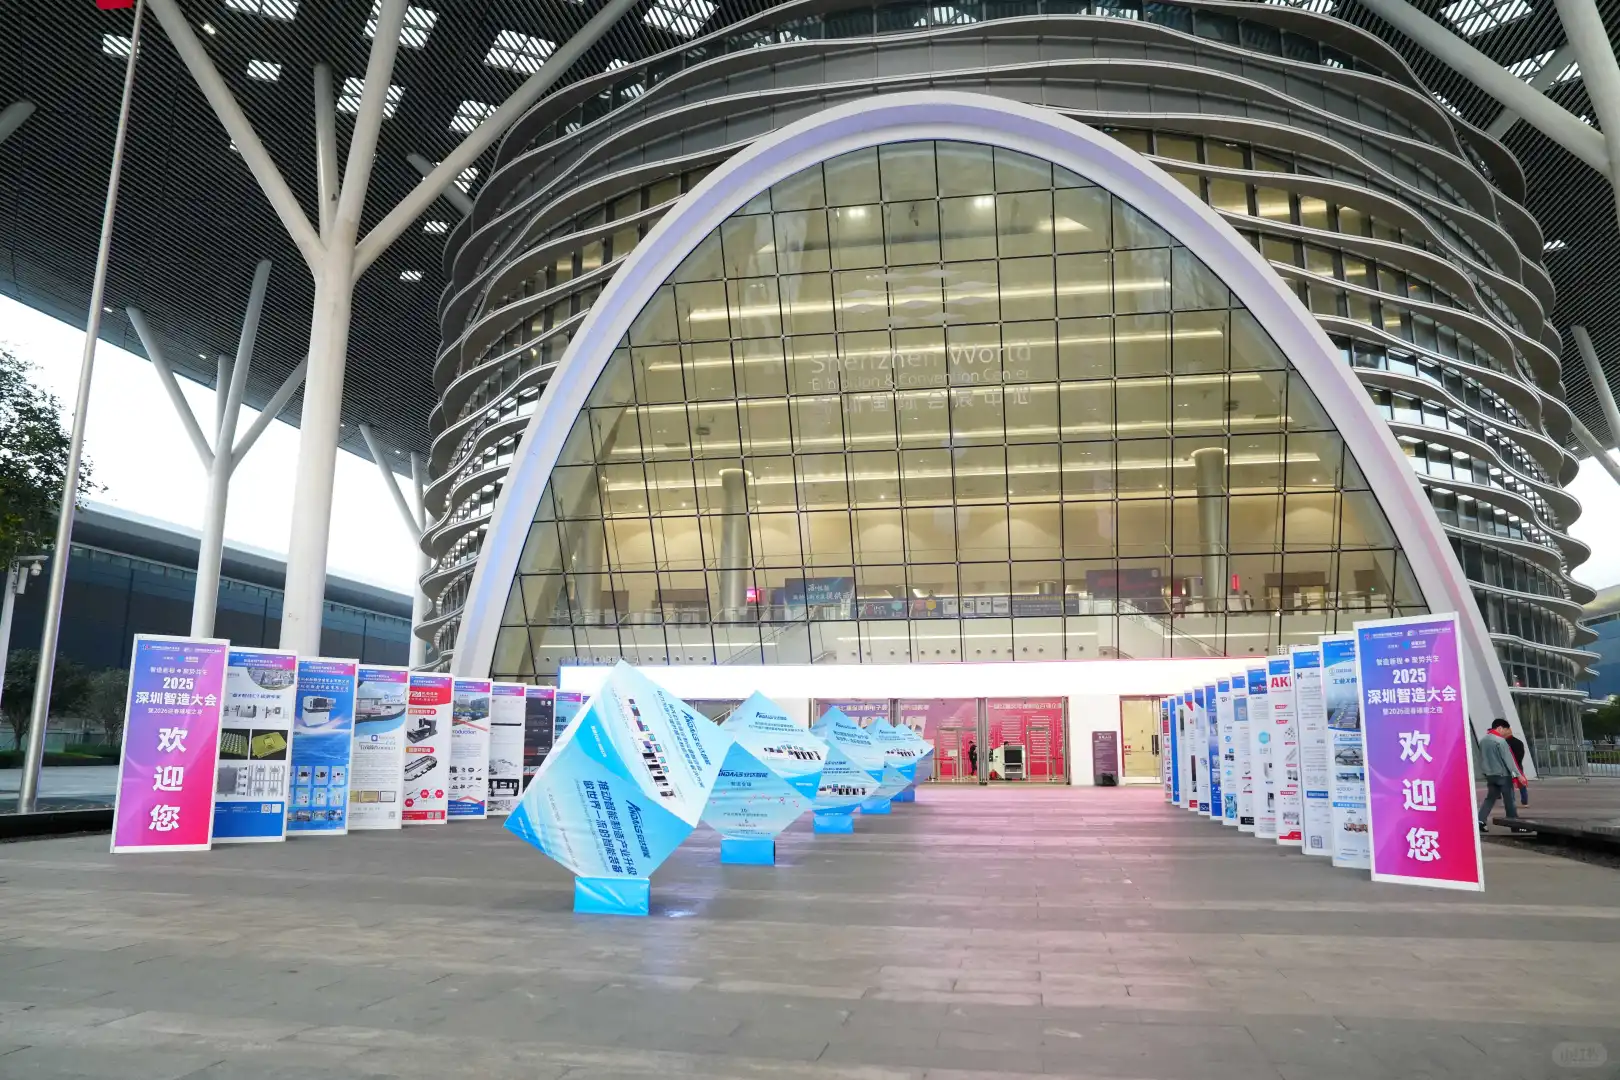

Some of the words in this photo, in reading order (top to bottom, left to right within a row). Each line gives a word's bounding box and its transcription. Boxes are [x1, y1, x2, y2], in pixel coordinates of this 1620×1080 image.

[950, 340, 1031, 364] World
[811, 375, 879, 391] Ehbition
[984, 368, 1030, 383] Cener
[162, 676, 194, 690] 2025
[1392, 667, 1427, 685] 2025
[135, 691, 217, 707] 深圳智造大会
[1367, 685, 1457, 705] 深圳智造大会
[148, 727, 188, 832] 欢迎您
[1398, 729, 1441, 862] 欢迎您
